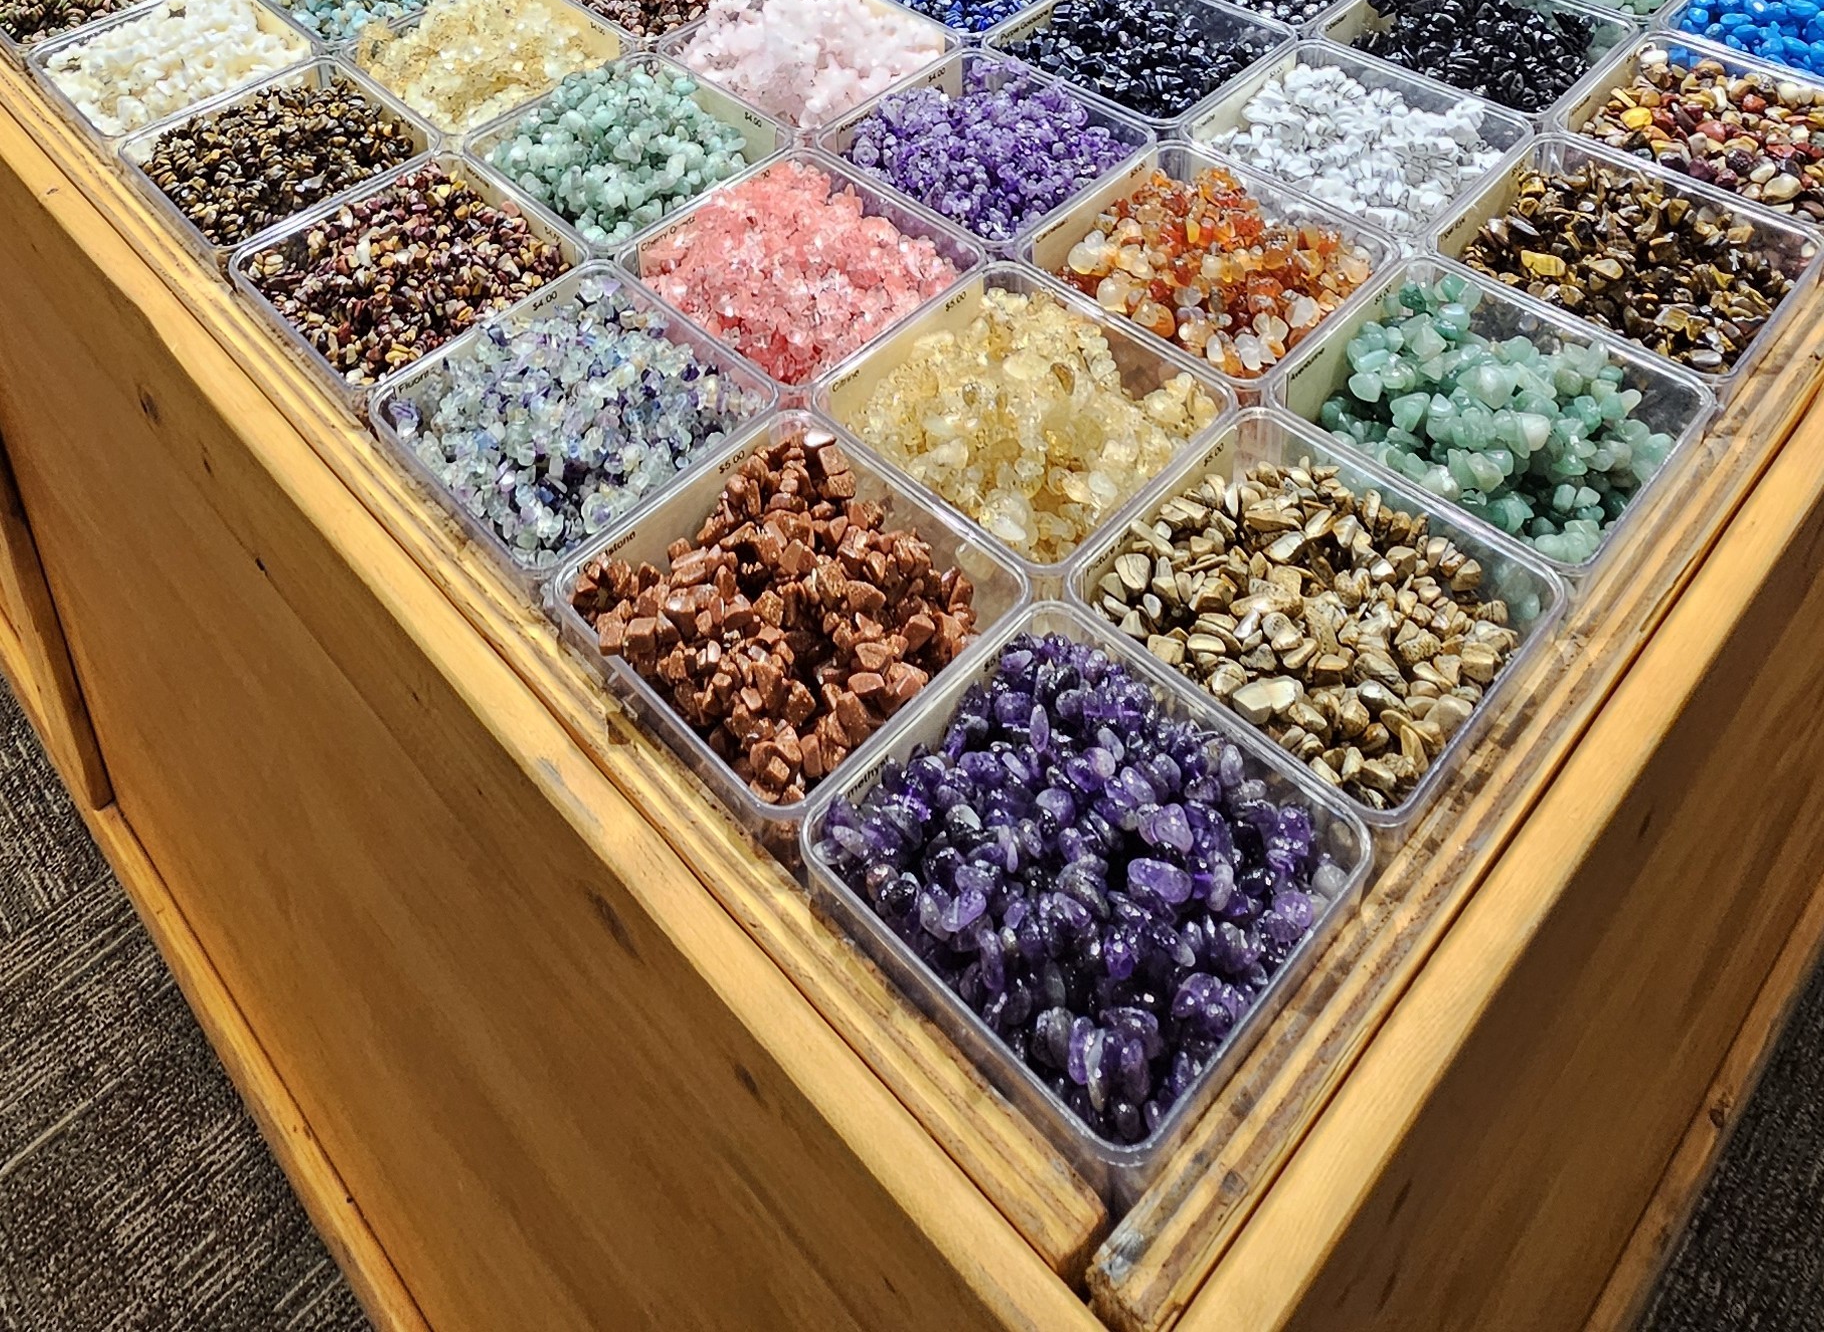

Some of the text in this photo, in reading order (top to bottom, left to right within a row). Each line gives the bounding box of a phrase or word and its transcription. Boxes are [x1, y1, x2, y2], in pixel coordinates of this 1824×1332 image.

[640, 216, 696, 252] Cherry Qrtz
[532, 290, 558, 311] $4.00
[945, 291, 967, 312] $5.00
[719, 450, 745, 474] $5.00
[847, 754, 889, 798] methyst
